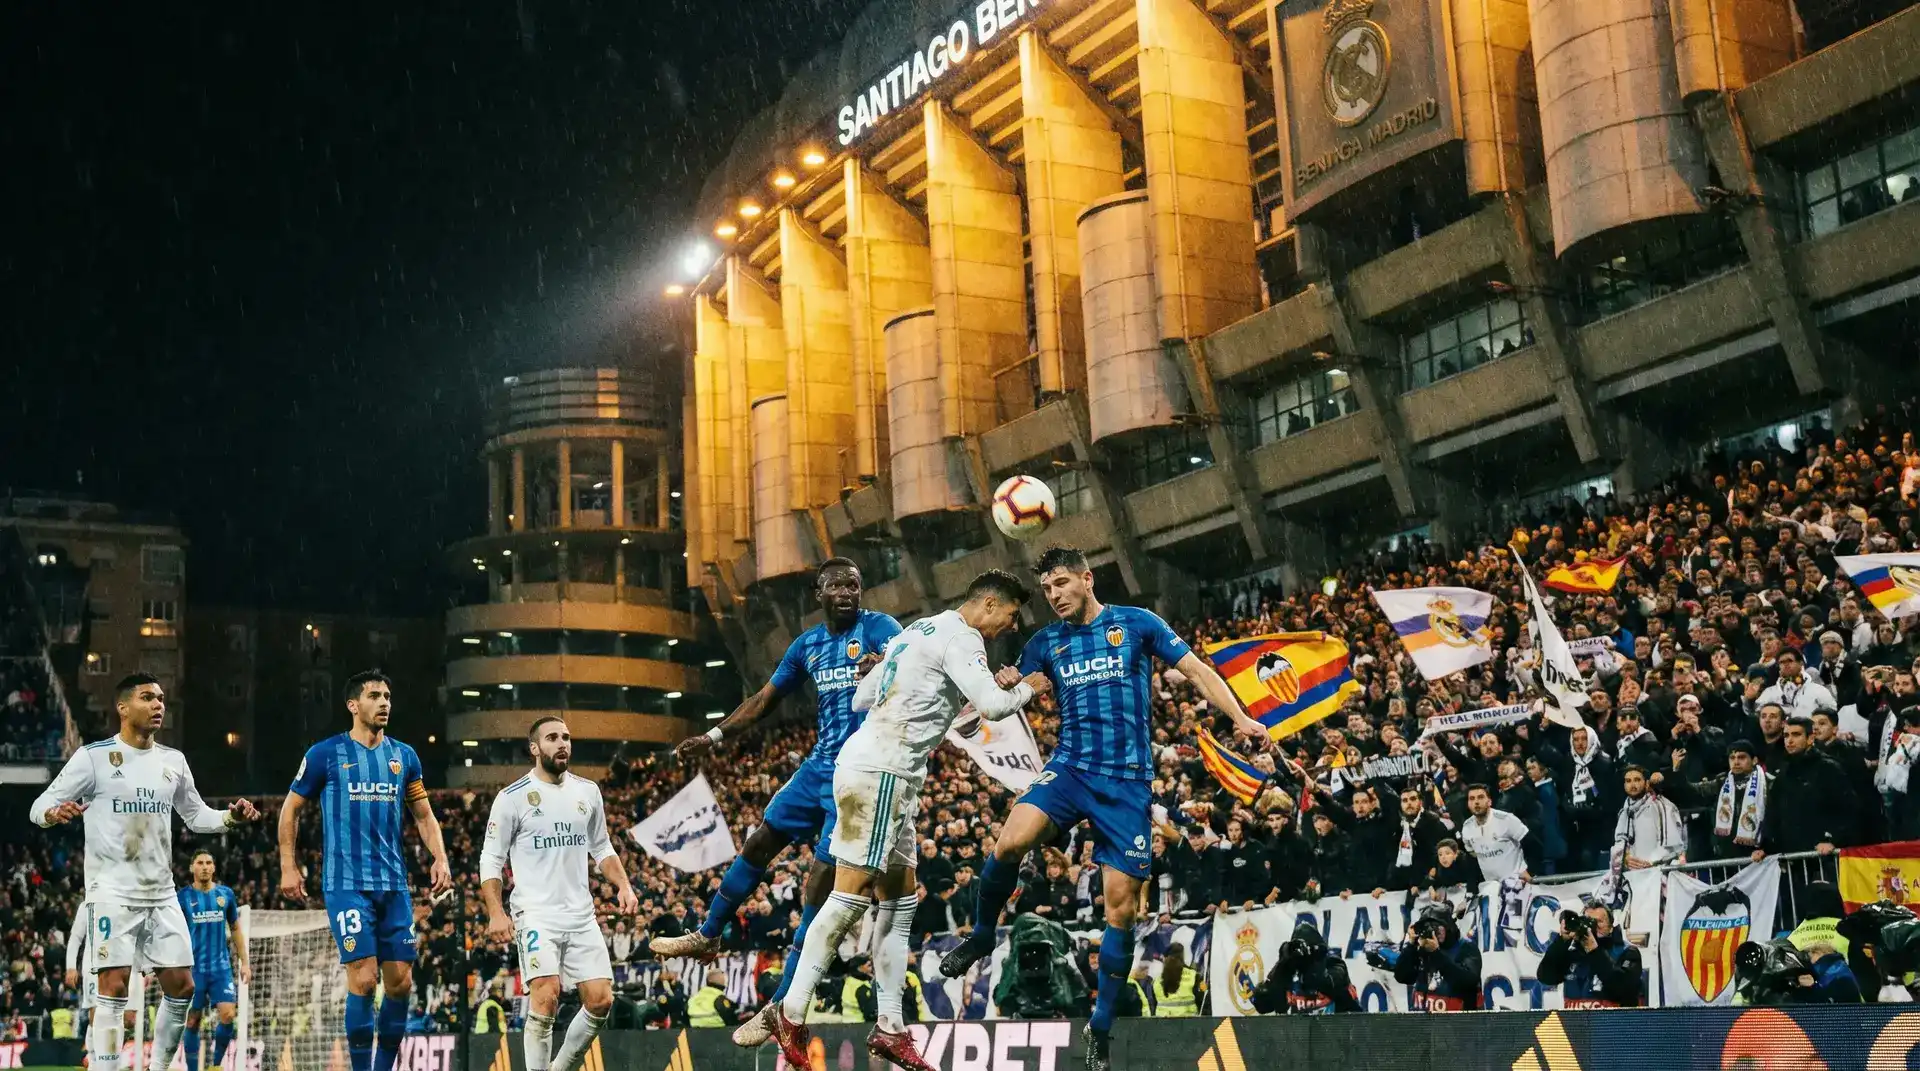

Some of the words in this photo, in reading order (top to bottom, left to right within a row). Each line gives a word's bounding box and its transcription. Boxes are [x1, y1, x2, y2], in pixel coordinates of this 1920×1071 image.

[838, 20, 969, 146] SANTIAGO
[136, 787, 155, 800] Fly
[347, 782, 399, 795] UUCH
[533, 832, 587, 850] Emirates
[98, 916, 112, 941] 9
[336, 908, 363, 937] 13
[526, 929, 540, 953] 2
